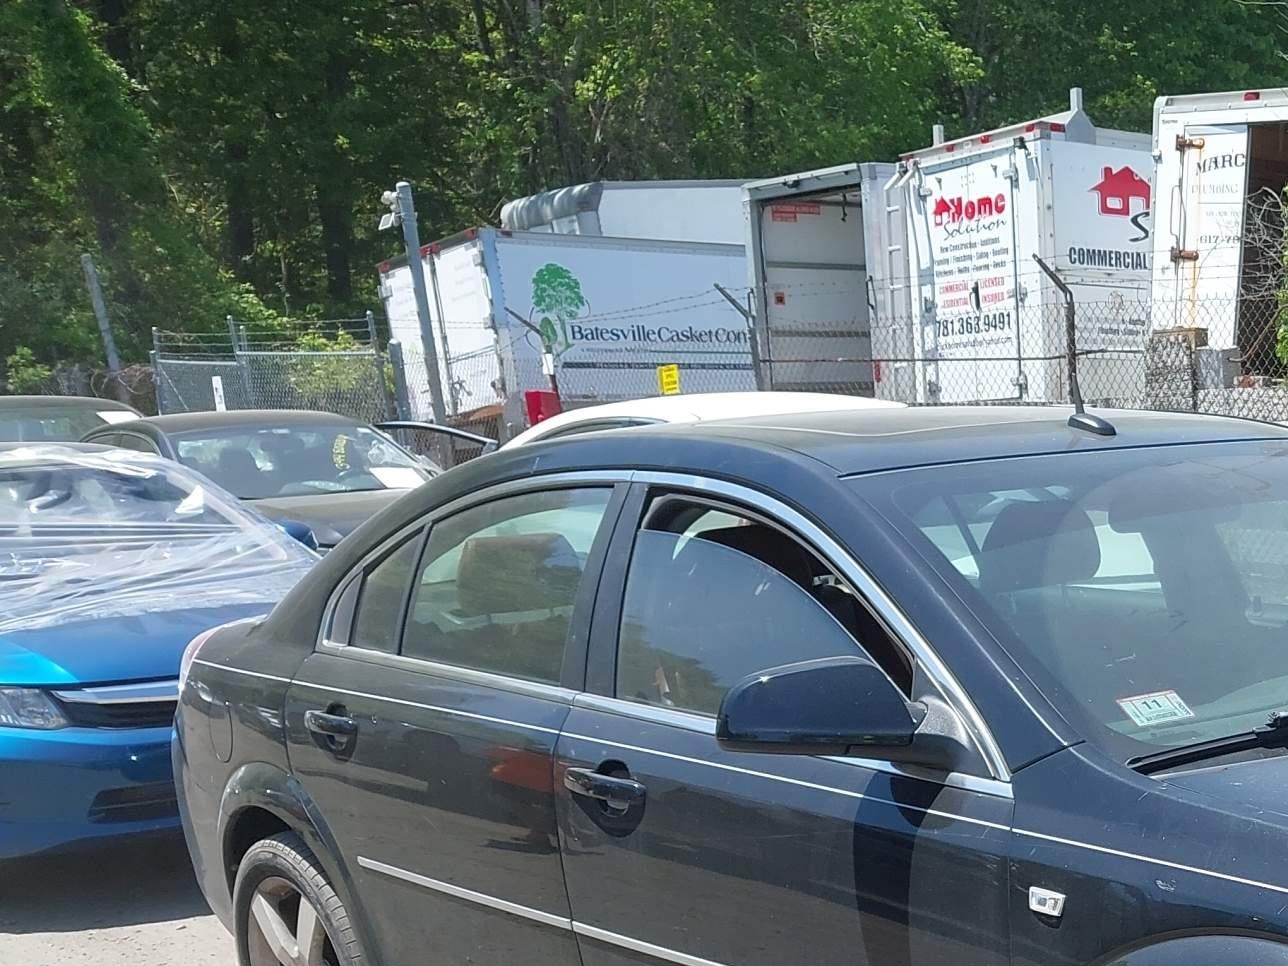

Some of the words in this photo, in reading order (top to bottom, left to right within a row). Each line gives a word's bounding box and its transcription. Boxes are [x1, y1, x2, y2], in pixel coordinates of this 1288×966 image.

[949, 193, 1006, 223] Home
[1068, 246, 1148, 271] COMMERCIAL
[570, 325, 657, 342] Batesville
[657, 326, 714, 344] Casket
[936, 311, 1012, 338] 781.363.9491
